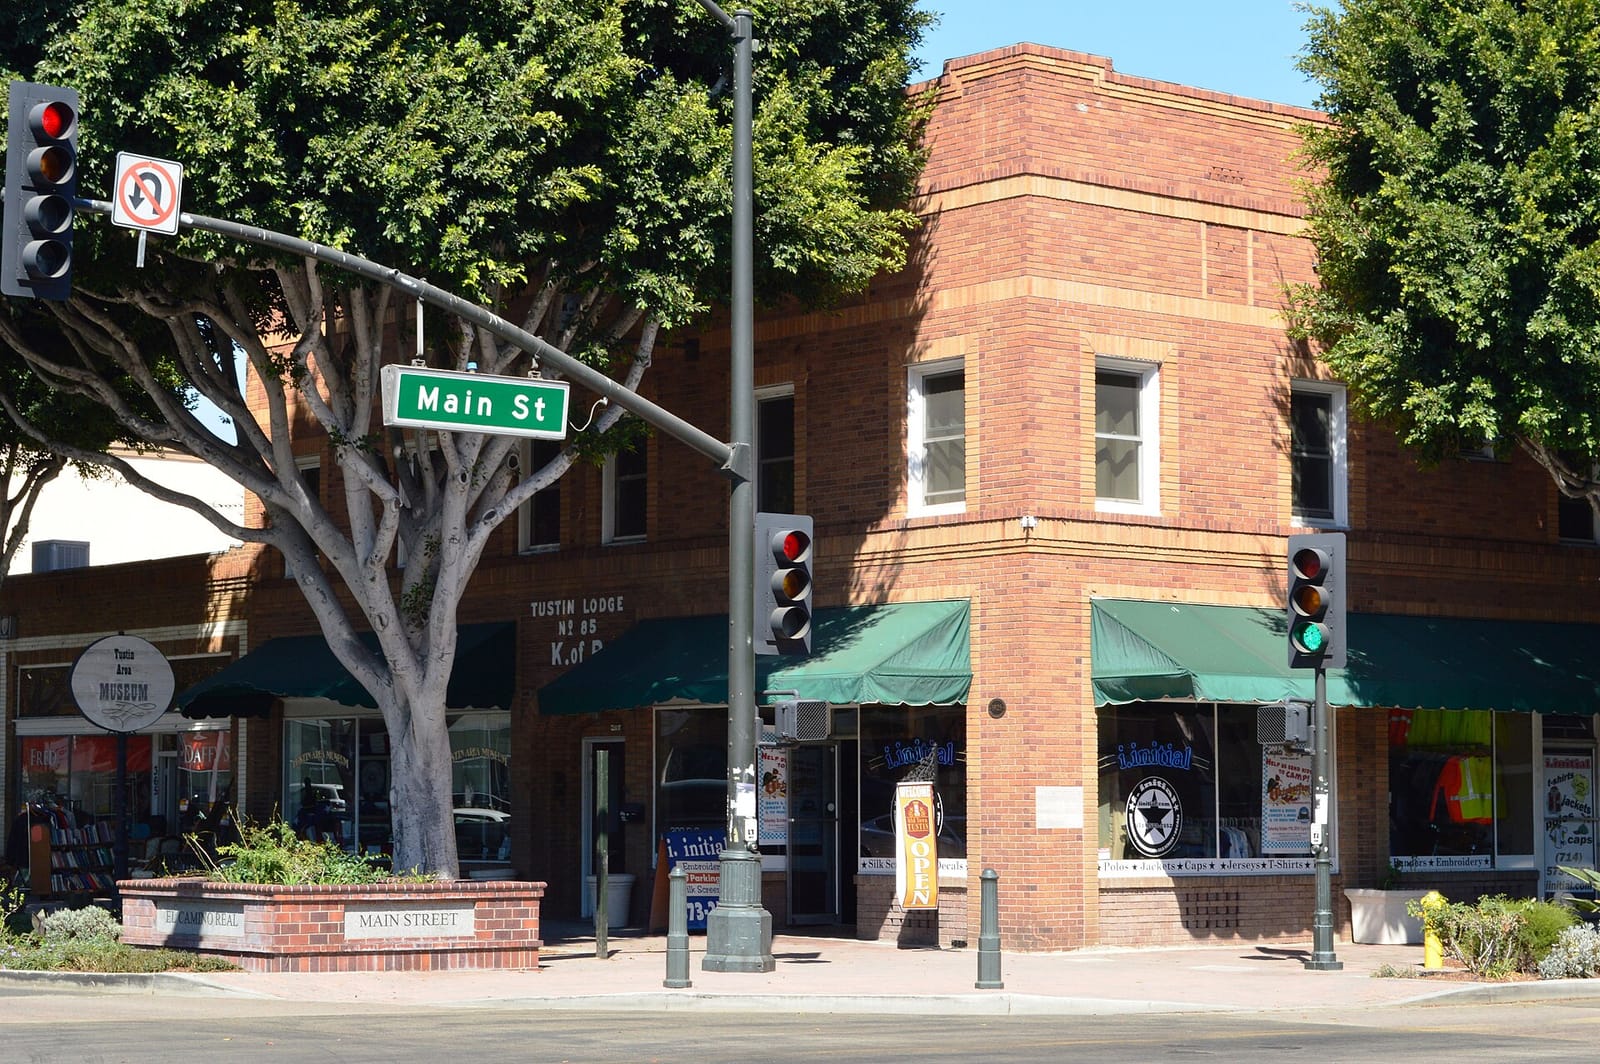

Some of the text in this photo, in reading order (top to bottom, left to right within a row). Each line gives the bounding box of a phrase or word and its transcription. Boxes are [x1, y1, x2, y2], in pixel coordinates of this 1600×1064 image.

[417, 385, 546, 422] Main St
[531, 596, 624, 617] TUSTIN LODGE
[580, 618, 597, 636] 85
[114, 648, 135, 660] Tustin
[116, 664, 132, 675] Area
[99, 682, 149, 702] MUSEUM
[1266, 758, 1280, 766] HELP
[1286, 772, 1310, 783] CAMP!
[1547, 772, 1574, 787] t-shirts
[1567, 836, 1593, 846] caps
[868, 859, 884, 870] Silk
[1436, 857, 1482, 868] Embroidery
[1555, 852, 1583, 864] (714)
[683, 862, 720, 873] Embroider
[1104, 862, 1129, 872] Polos
[1140, 860, 1176, 872] Jackets
[1184, 860, 1207, 874] Caps
[1227, 860, 1261, 872] Jerseys
[1268, 859, 1304, 870] T-Shirts
[910, 841, 930, 906] OPEN
[166, 910, 238, 927] EL CAMINO REAL
[360, 912, 458, 928] MAIN STREET
